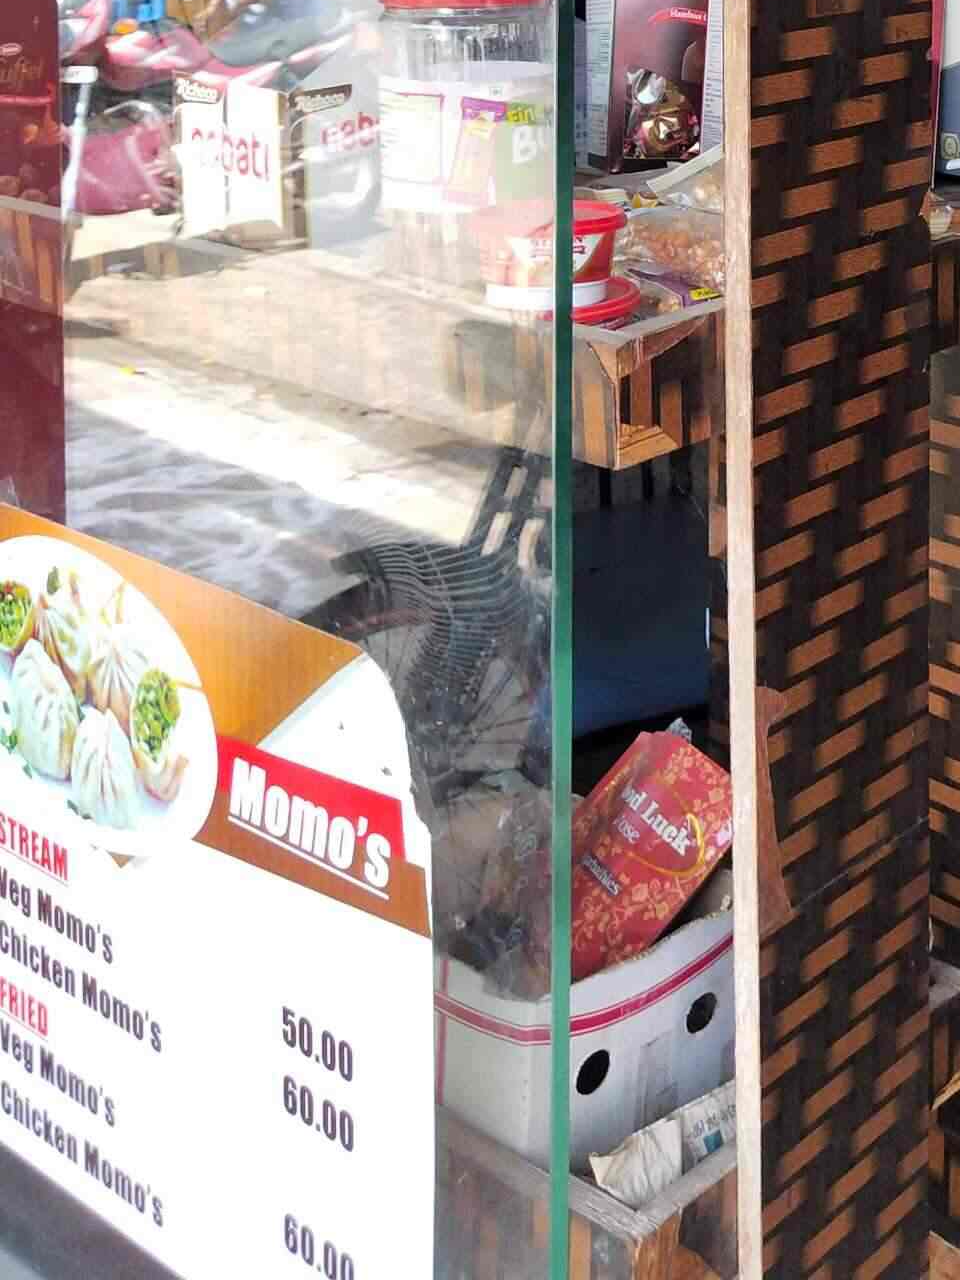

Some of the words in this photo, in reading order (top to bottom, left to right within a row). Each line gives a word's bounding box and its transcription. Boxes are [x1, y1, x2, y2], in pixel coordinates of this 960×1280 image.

[229, 756, 392, 888] Momo's
[641, 799, 692, 857] Luck
[37, 887, 113, 965] Momo's
[0, 923, 76, 997] Chicken
[82, 969, 162, 1053] Momo's
[0, 976, 49, 1038] FRIED
[0, 1021, 33, 1074] Veg
[39, 1045, 115, 1127] Momo's
[281, 1005, 354, 1082] 50.00
[283, 1074, 354, 1152] 60.00
[0, 1080, 78, 1164] Chicken
[84, 1139, 163, 1227] Momo's
[284, 1213, 355, 1280] 60.00
